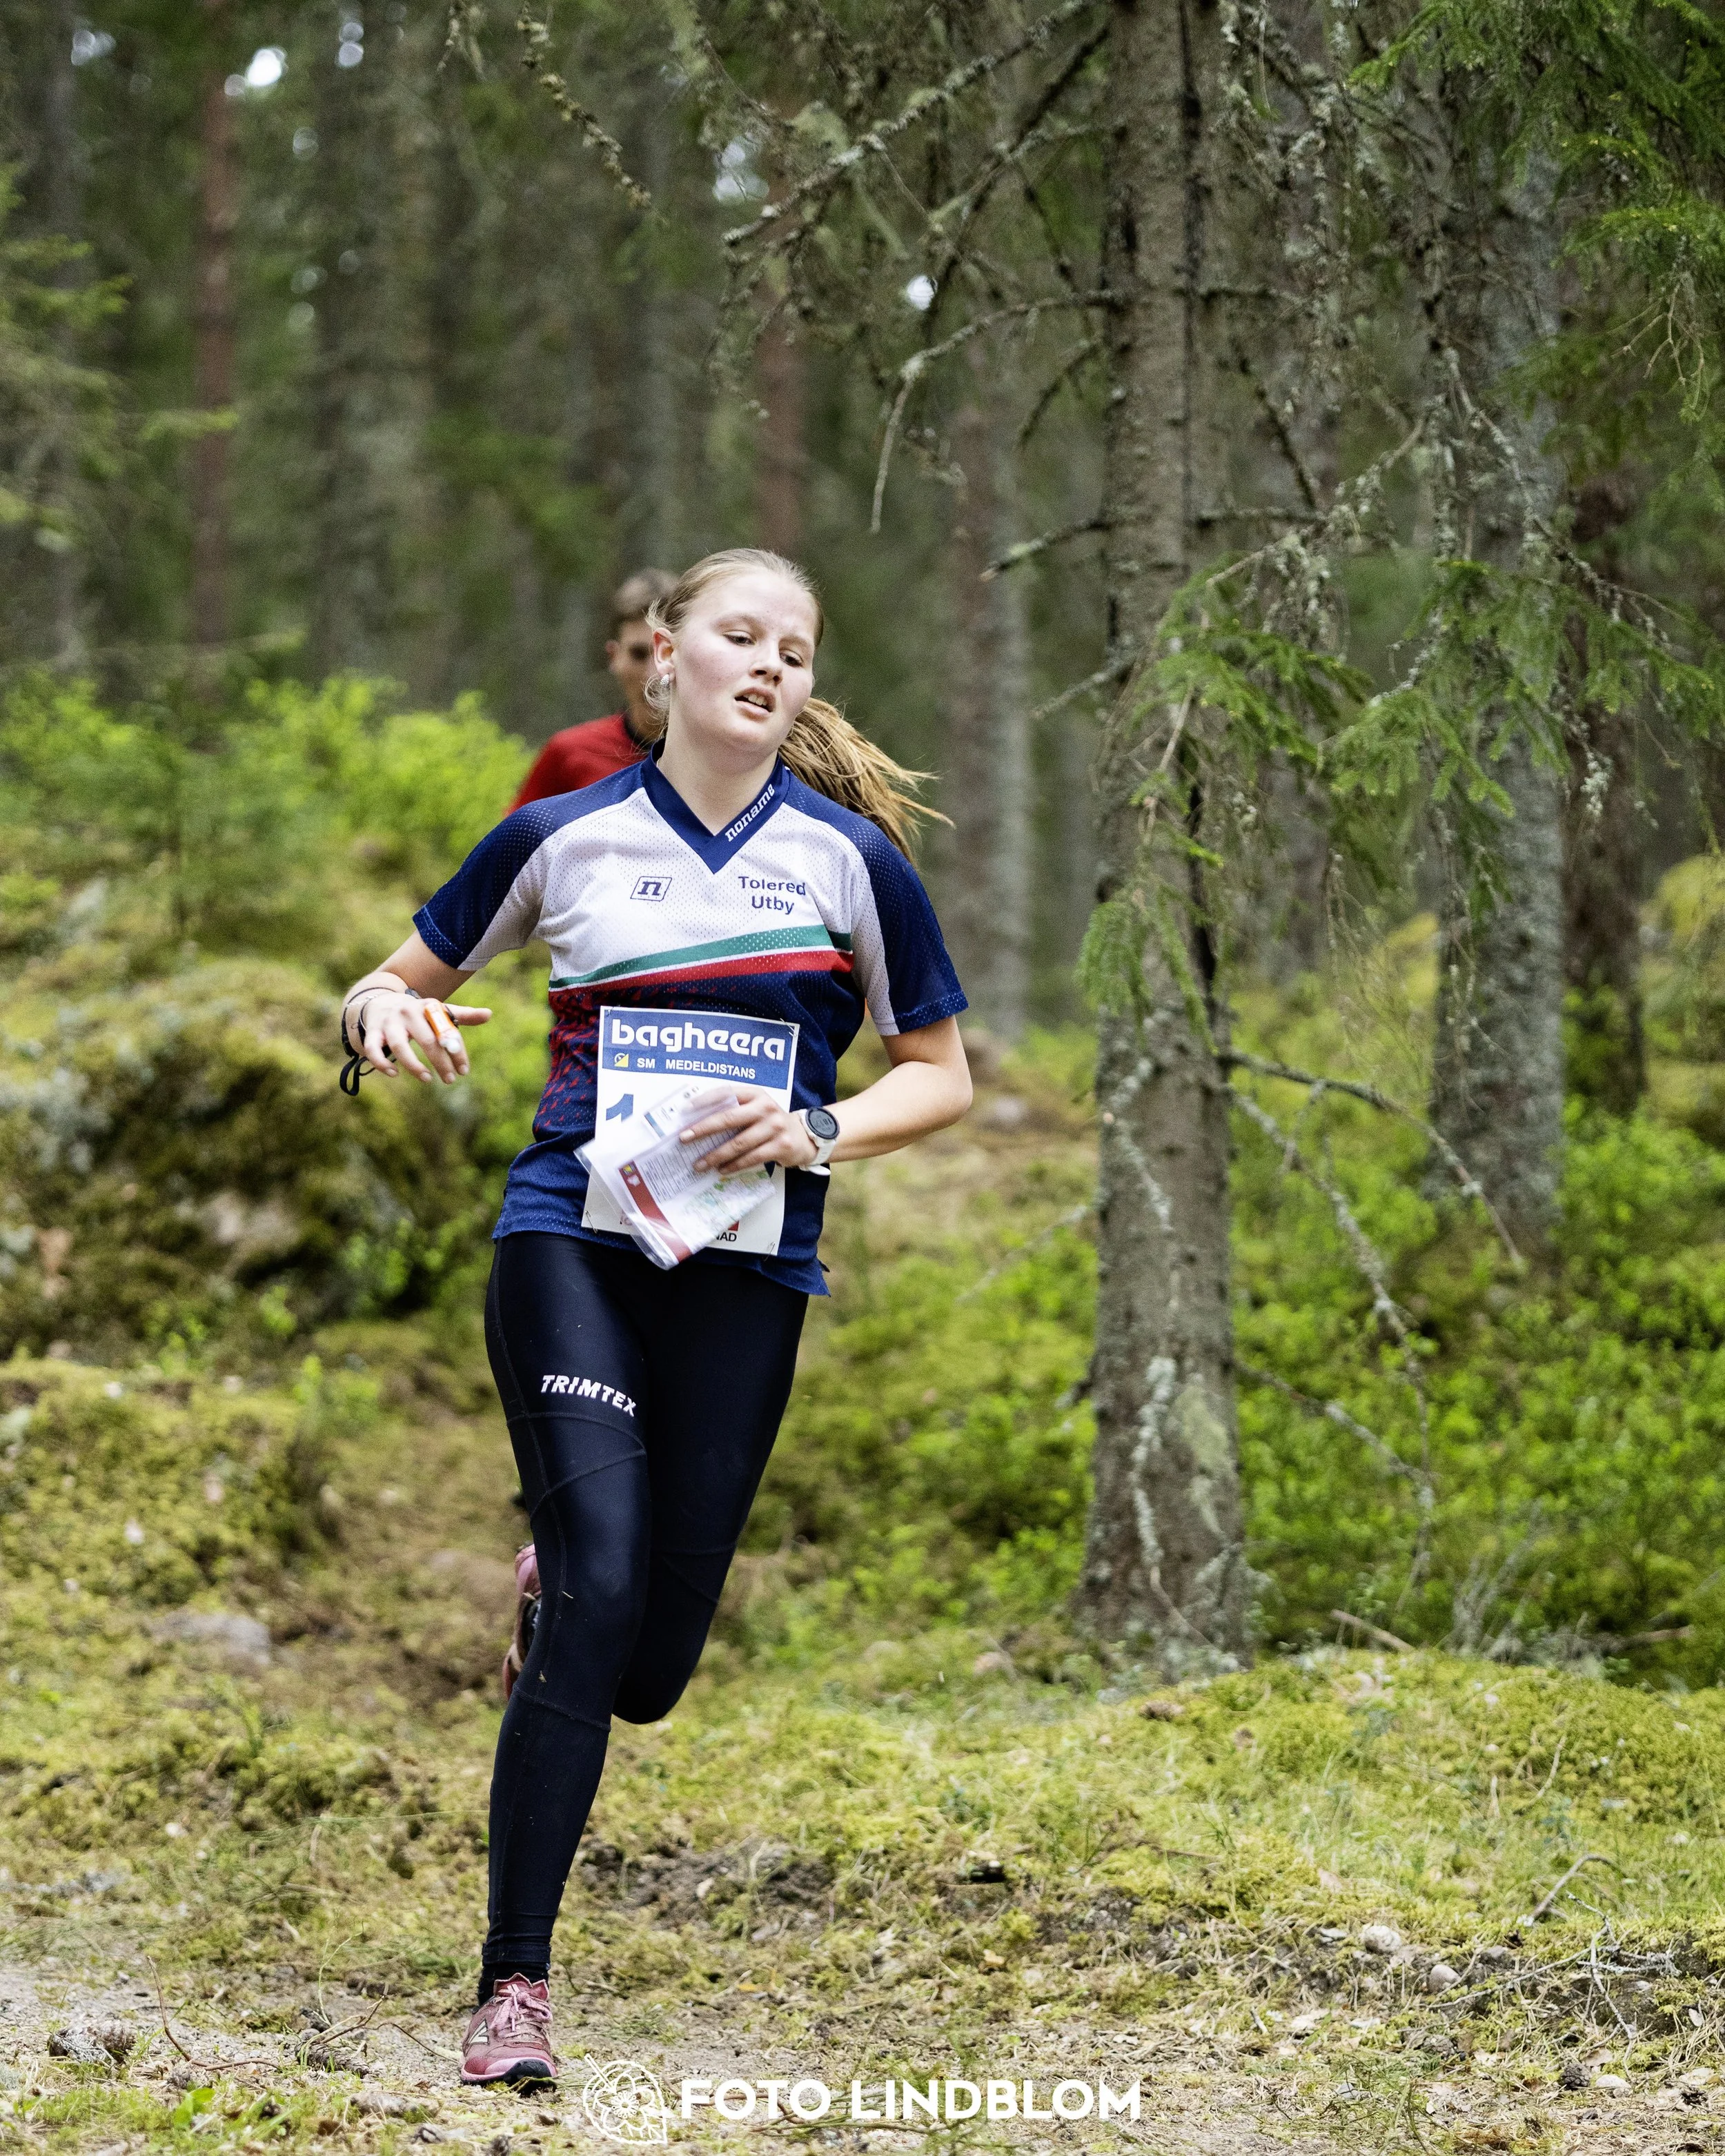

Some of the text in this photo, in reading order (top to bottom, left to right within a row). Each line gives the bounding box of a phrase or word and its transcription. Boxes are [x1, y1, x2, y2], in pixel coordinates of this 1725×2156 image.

[724, 784, 776, 842] noname
[738, 876, 807, 896] Tolered
[751, 896, 795, 915] Utby
[611, 1018, 786, 1062] bagheera
[636, 1057, 756, 1080] SM MEDELDISTANS
[540, 1374, 637, 1418] TRIMTEX
